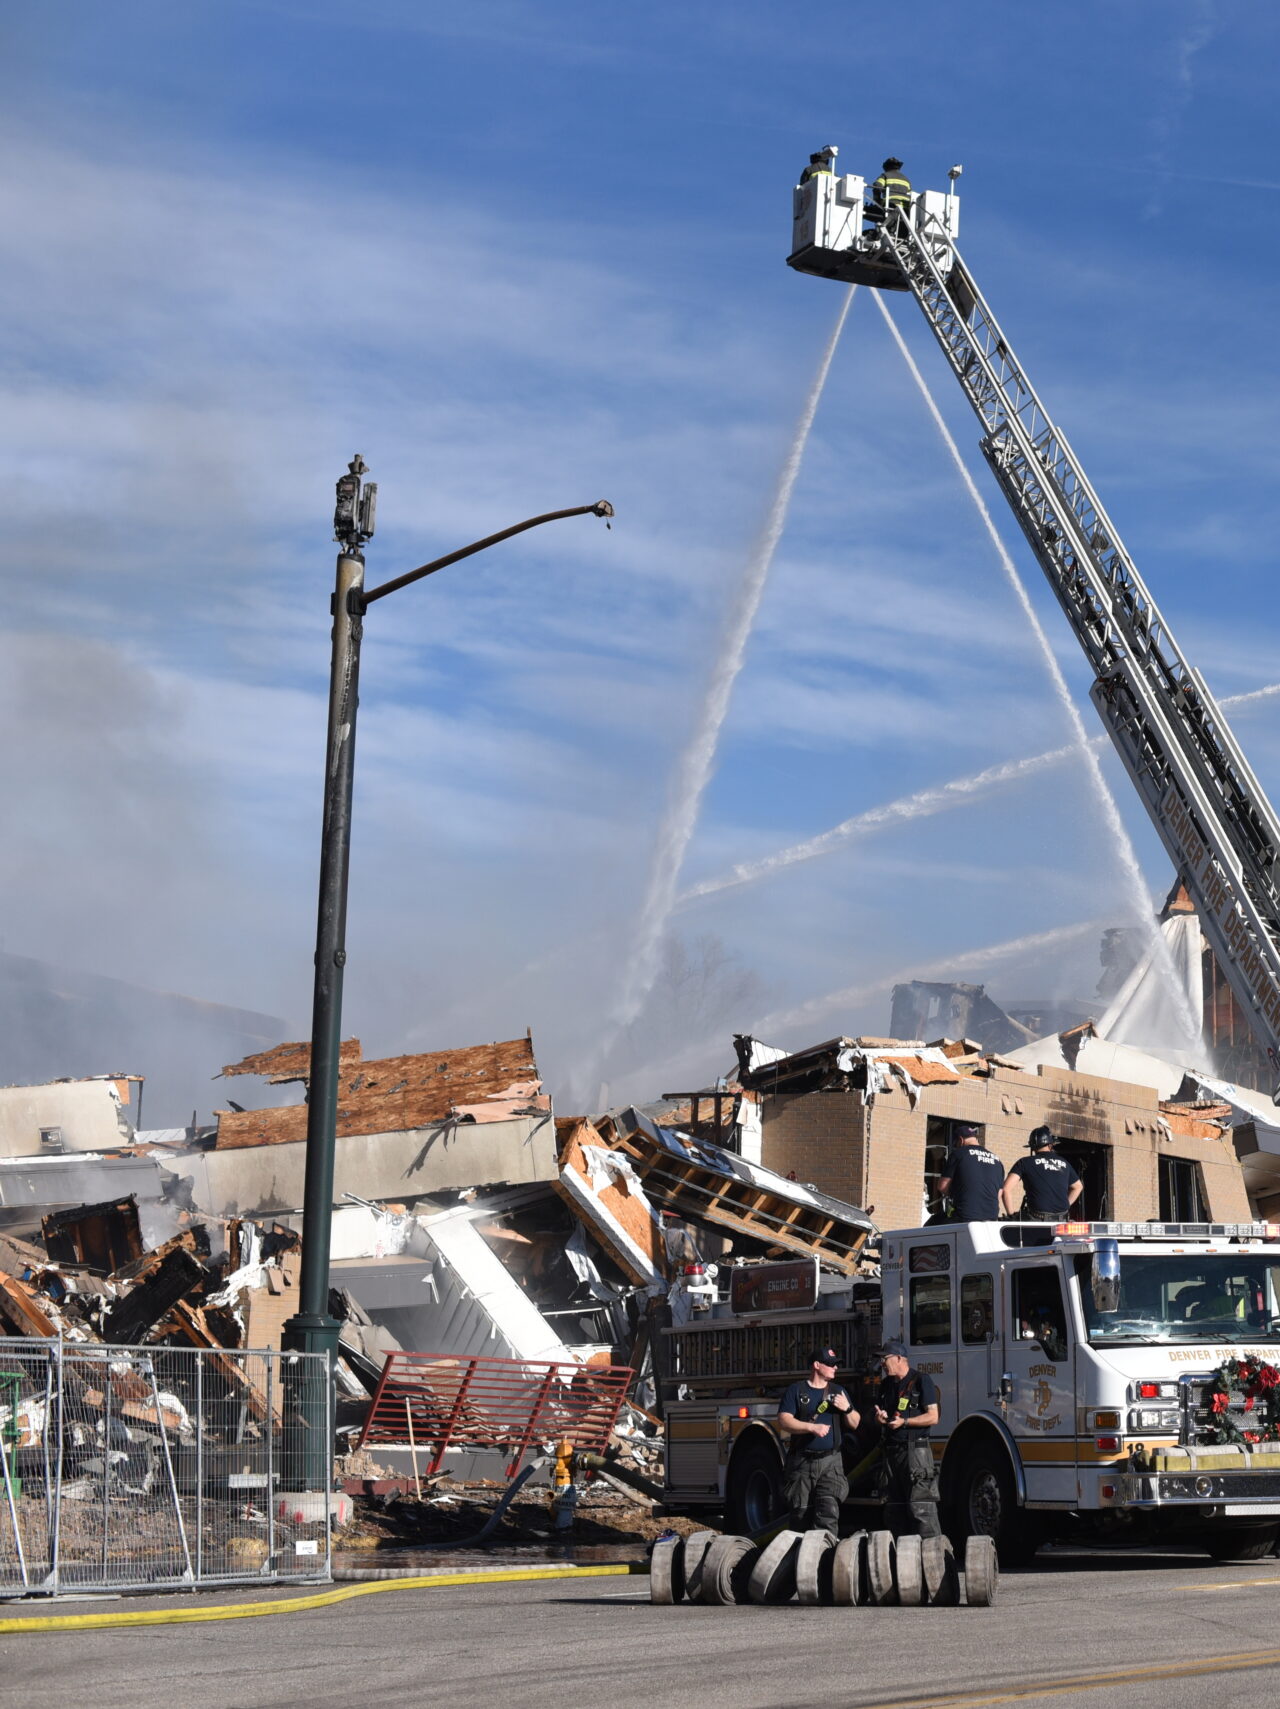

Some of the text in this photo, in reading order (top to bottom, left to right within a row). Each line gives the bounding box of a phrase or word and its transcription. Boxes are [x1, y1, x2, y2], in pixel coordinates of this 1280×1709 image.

[1166, 793, 1204, 870] DENVER
[1201, 867, 1227, 916] FIRE
[977, 1156, 996, 1165] FIRE
[767, 1279, 790, 1293] ENGINE
[1168, 1350, 1212, 1363] DENVER
[1215, 1349, 1240, 1360] FIRE
[917, 1362, 944, 1375] ENGINE
[1029, 1364, 1057, 1378] DENVER
[1025, 1414, 1041, 1431] FIRE
